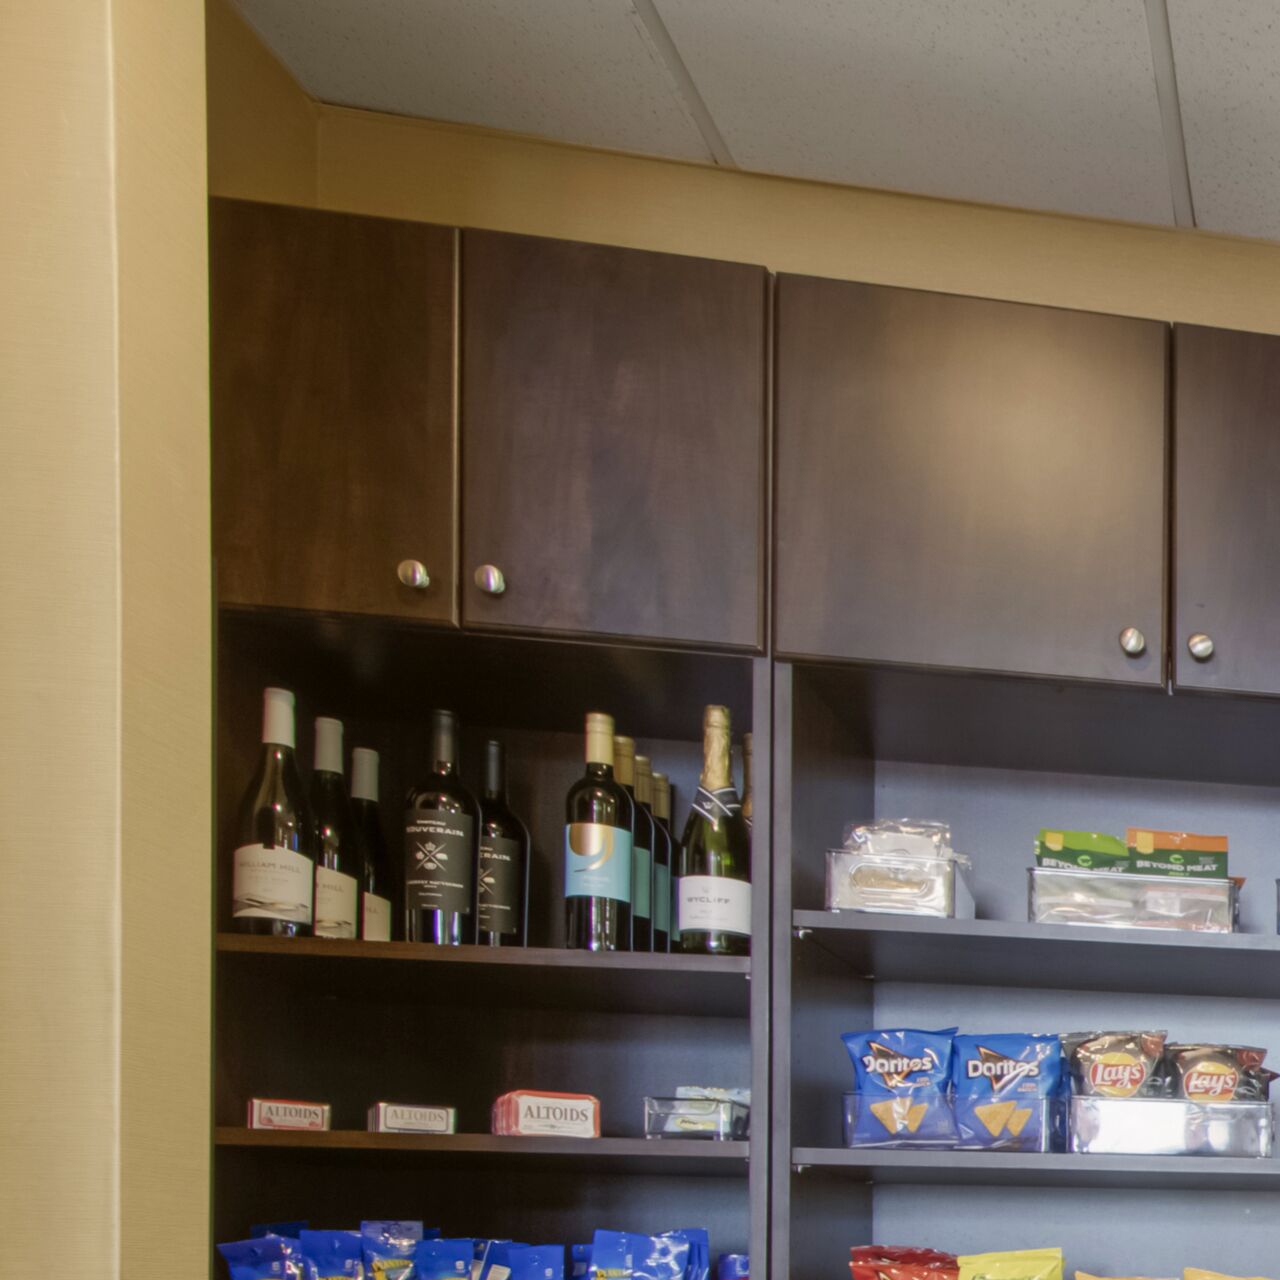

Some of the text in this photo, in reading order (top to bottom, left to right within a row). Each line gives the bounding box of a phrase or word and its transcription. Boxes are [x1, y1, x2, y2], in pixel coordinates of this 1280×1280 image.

[1136, 859, 1219, 873] BEYOND MEAT
[863, 1055, 933, 1073] Doritos
[968, 1059, 1040, 1078] Doritos
[265, 1104, 320, 1121] ALTOIDS
[390, 1107, 445, 1124] ALTOIDS
[523, 1104, 589, 1123] ALTOIDS
